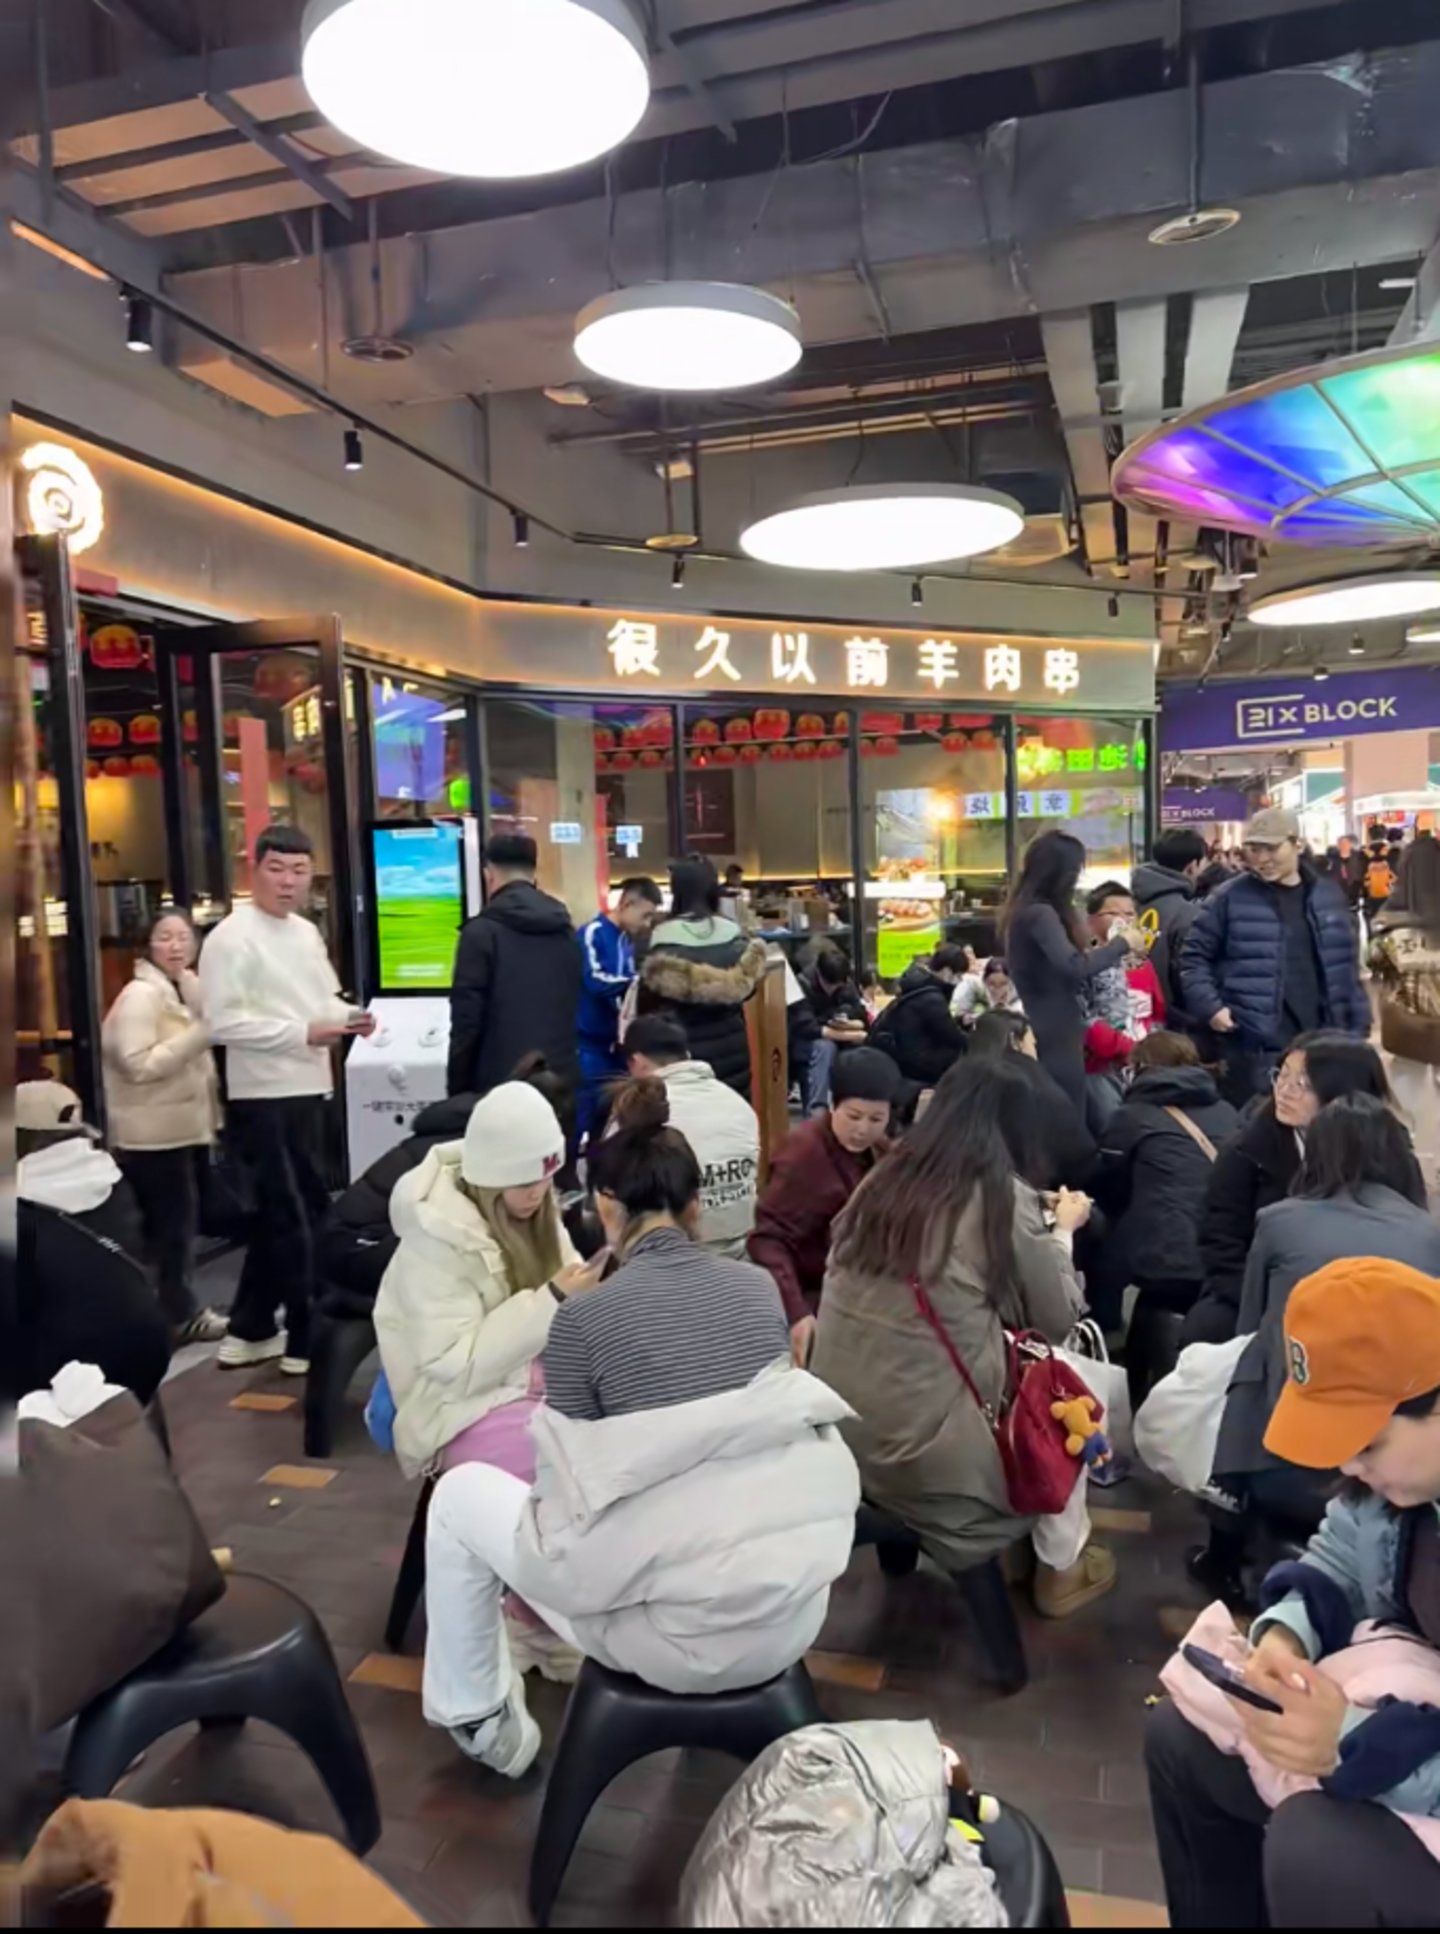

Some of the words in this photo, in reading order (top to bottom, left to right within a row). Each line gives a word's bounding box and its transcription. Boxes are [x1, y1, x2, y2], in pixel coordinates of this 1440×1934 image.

[607, 618, 1082, 694] 很久以前羊肉串
[1304, 696, 1398, 723] BLOCK
